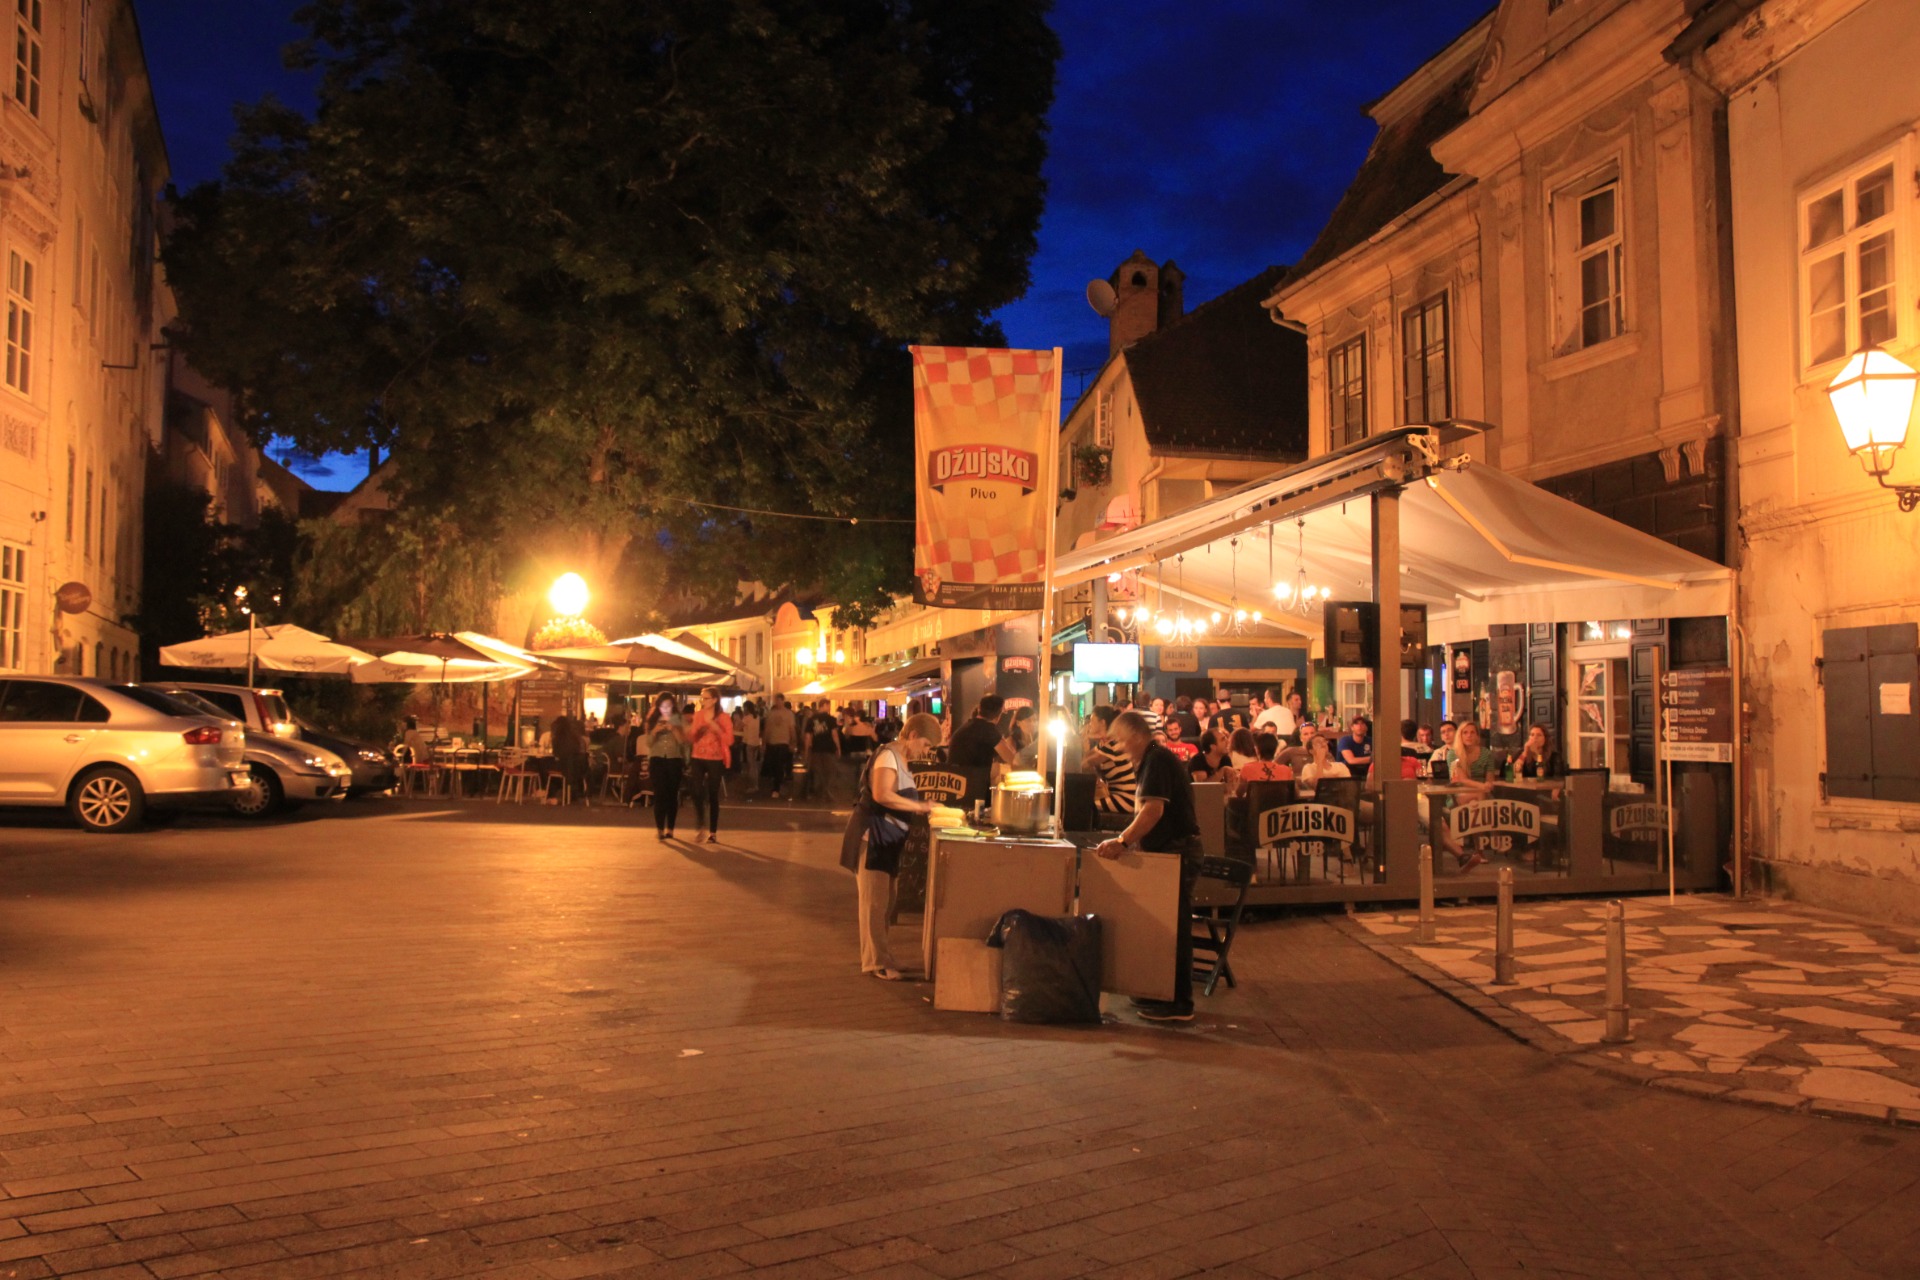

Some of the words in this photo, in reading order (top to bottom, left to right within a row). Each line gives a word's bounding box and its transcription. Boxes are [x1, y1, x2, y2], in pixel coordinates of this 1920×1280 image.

[936, 447, 1030, 481] Ožujsko
[970, 487, 997, 500] Pivo
[913, 773, 962, 791] Ožujsko
[924, 791, 947, 801] PUB
[1267, 805, 1347, 838] Ožujsko
[1458, 802, 1533, 833] Ožujsko
[1479, 835, 1513, 850] PUB
[1631, 830, 1657, 841] PUB
[1289, 840, 1325, 857] PUB
